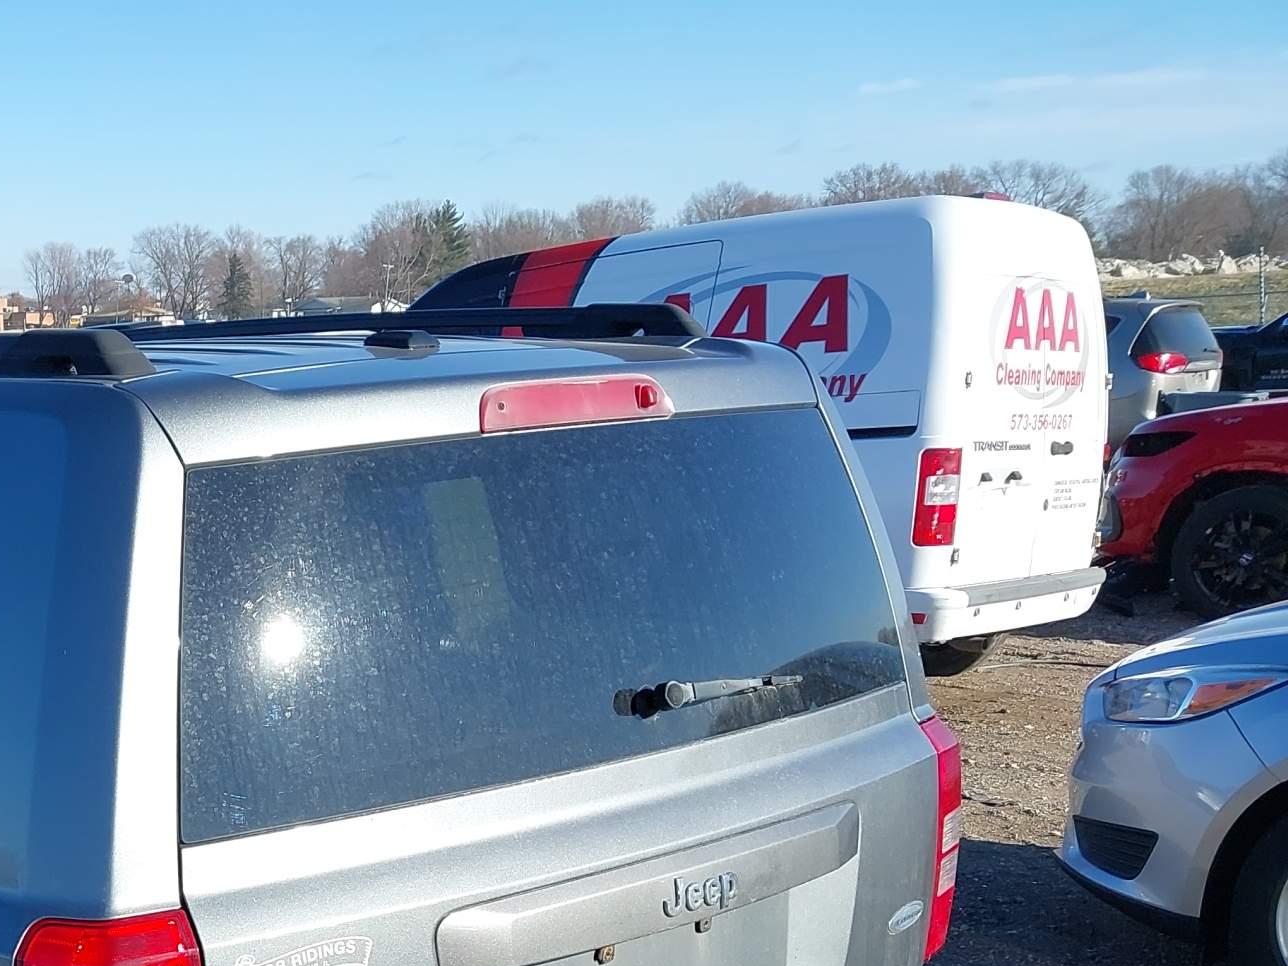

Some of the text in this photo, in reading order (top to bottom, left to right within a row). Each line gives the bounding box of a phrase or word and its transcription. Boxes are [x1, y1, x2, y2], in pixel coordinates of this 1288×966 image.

[665, 274, 849, 353] AA
[1004, 287, 1080, 352] AAA
[996, 362, 1086, 392] Cleaning Company
[1010, 414, 1073, 430] 573-356-0267
[973, 441, 1009, 452] TRANSIT
[662, 871, 738, 917] Jeep
[291, 940, 356, 966] RIDINGS
